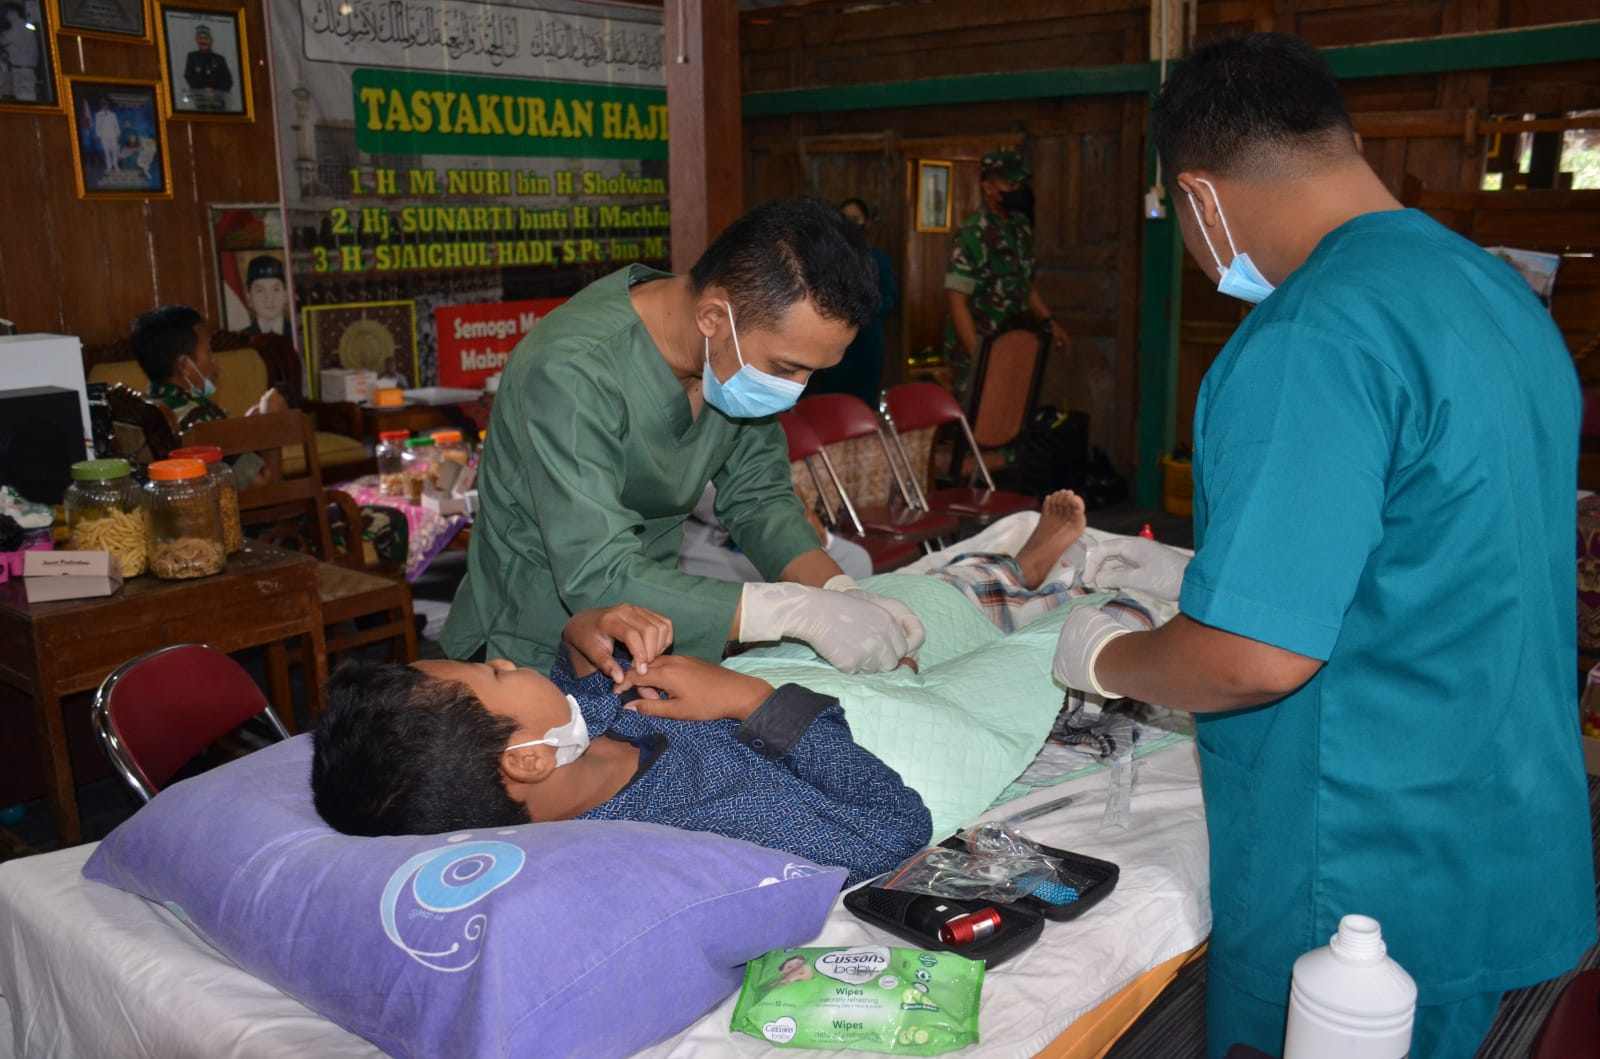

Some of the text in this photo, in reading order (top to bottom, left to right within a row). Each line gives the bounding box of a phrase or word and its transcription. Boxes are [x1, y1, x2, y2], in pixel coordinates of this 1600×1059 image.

[360, 87, 669, 140] TASYAKURAN HAJI
[351, 168, 368, 194] 1.
[447, 170, 510, 194] NURI
[516, 170, 549, 194] bin
[583, 172, 665, 194] Shofwan
[331, 207, 354, 234] 2.
[362, 207, 395, 240] Hj.
[402, 206, 513, 232] SUNARTI
[519, 206, 568, 230] binti
[313, 246, 335, 272] 3.
[610, 238, 639, 260] bin
[453, 317, 517, 339] Semoga
[822, 953, 885, 964] Cussons
[833, 963, 881, 976] baby
[835, 987, 864, 996] Wipes
[765, 1024, 794, 1034] Cussons
[832, 1020, 864, 1030] Wipes
